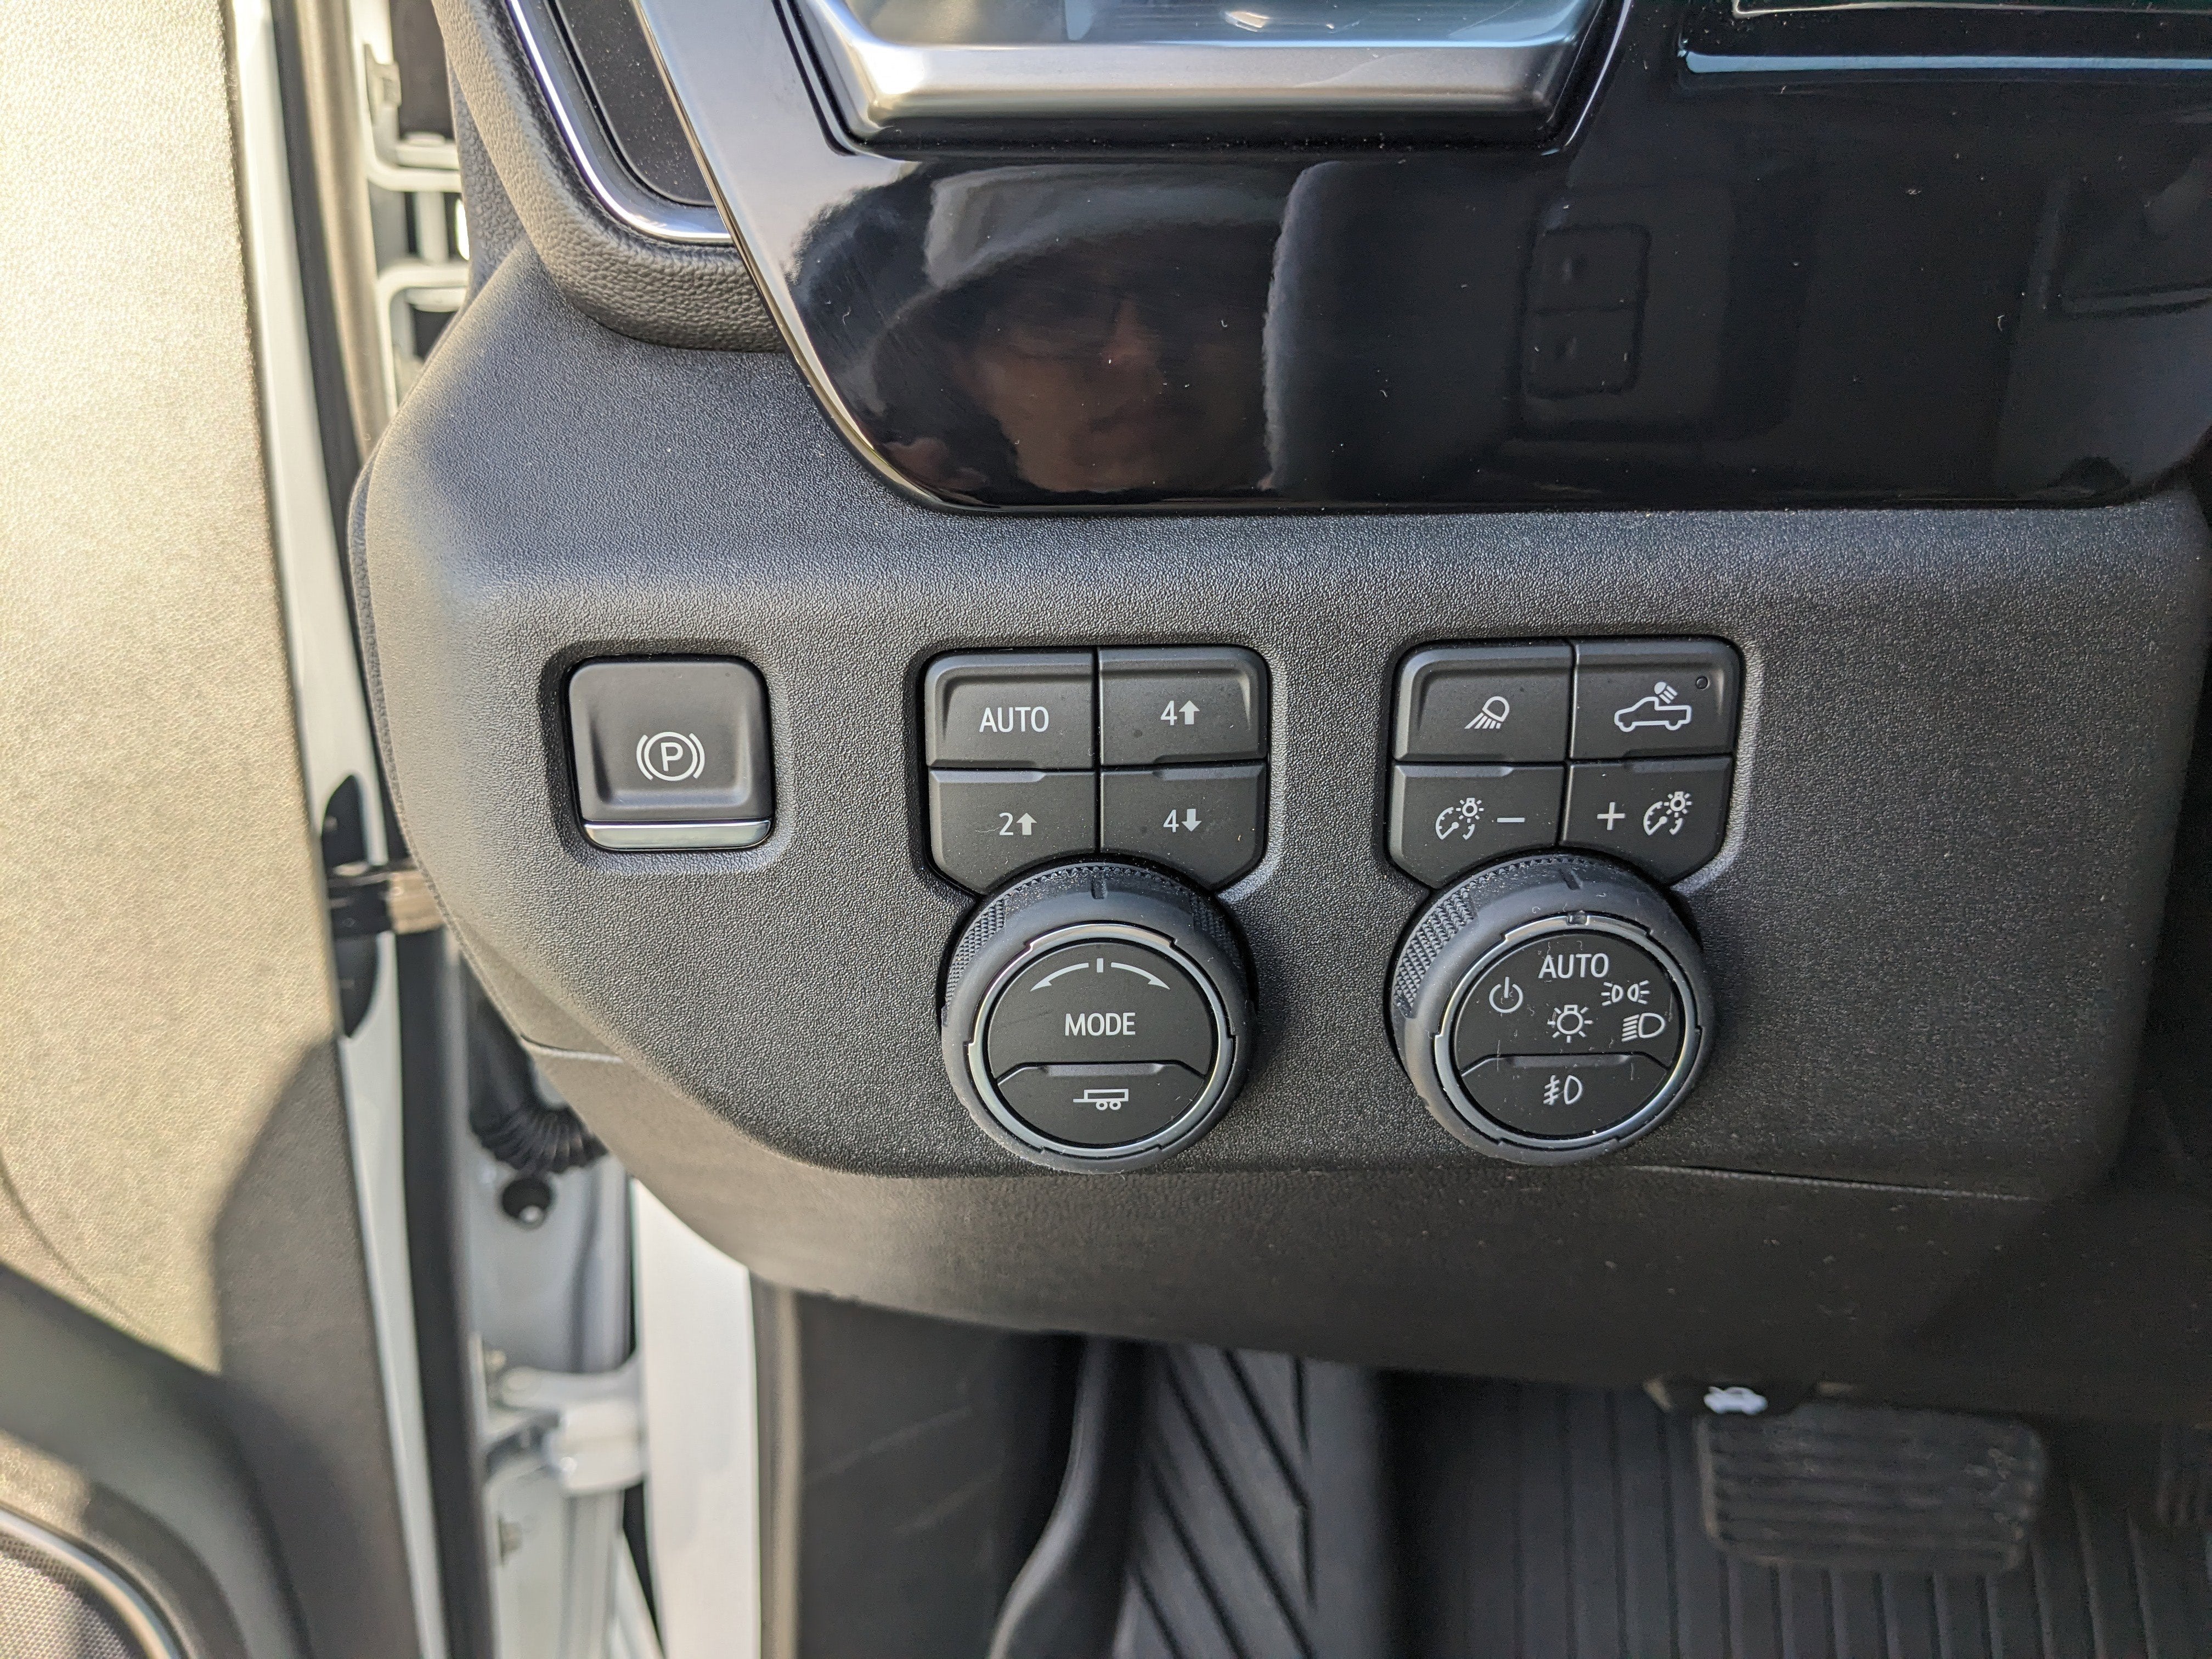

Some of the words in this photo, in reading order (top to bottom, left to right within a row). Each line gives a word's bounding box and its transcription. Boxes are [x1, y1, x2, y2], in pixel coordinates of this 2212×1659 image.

[979, 706, 1049, 732] AUTO
[1160, 700, 1177, 726] 4
[661, 742, 684, 771] P
[999, 812, 1014, 836] 2
[1163, 809, 1180, 833] 4
[1538, 953, 1609, 979] AUTO
[1065, 1012, 1136, 1036] MODE
